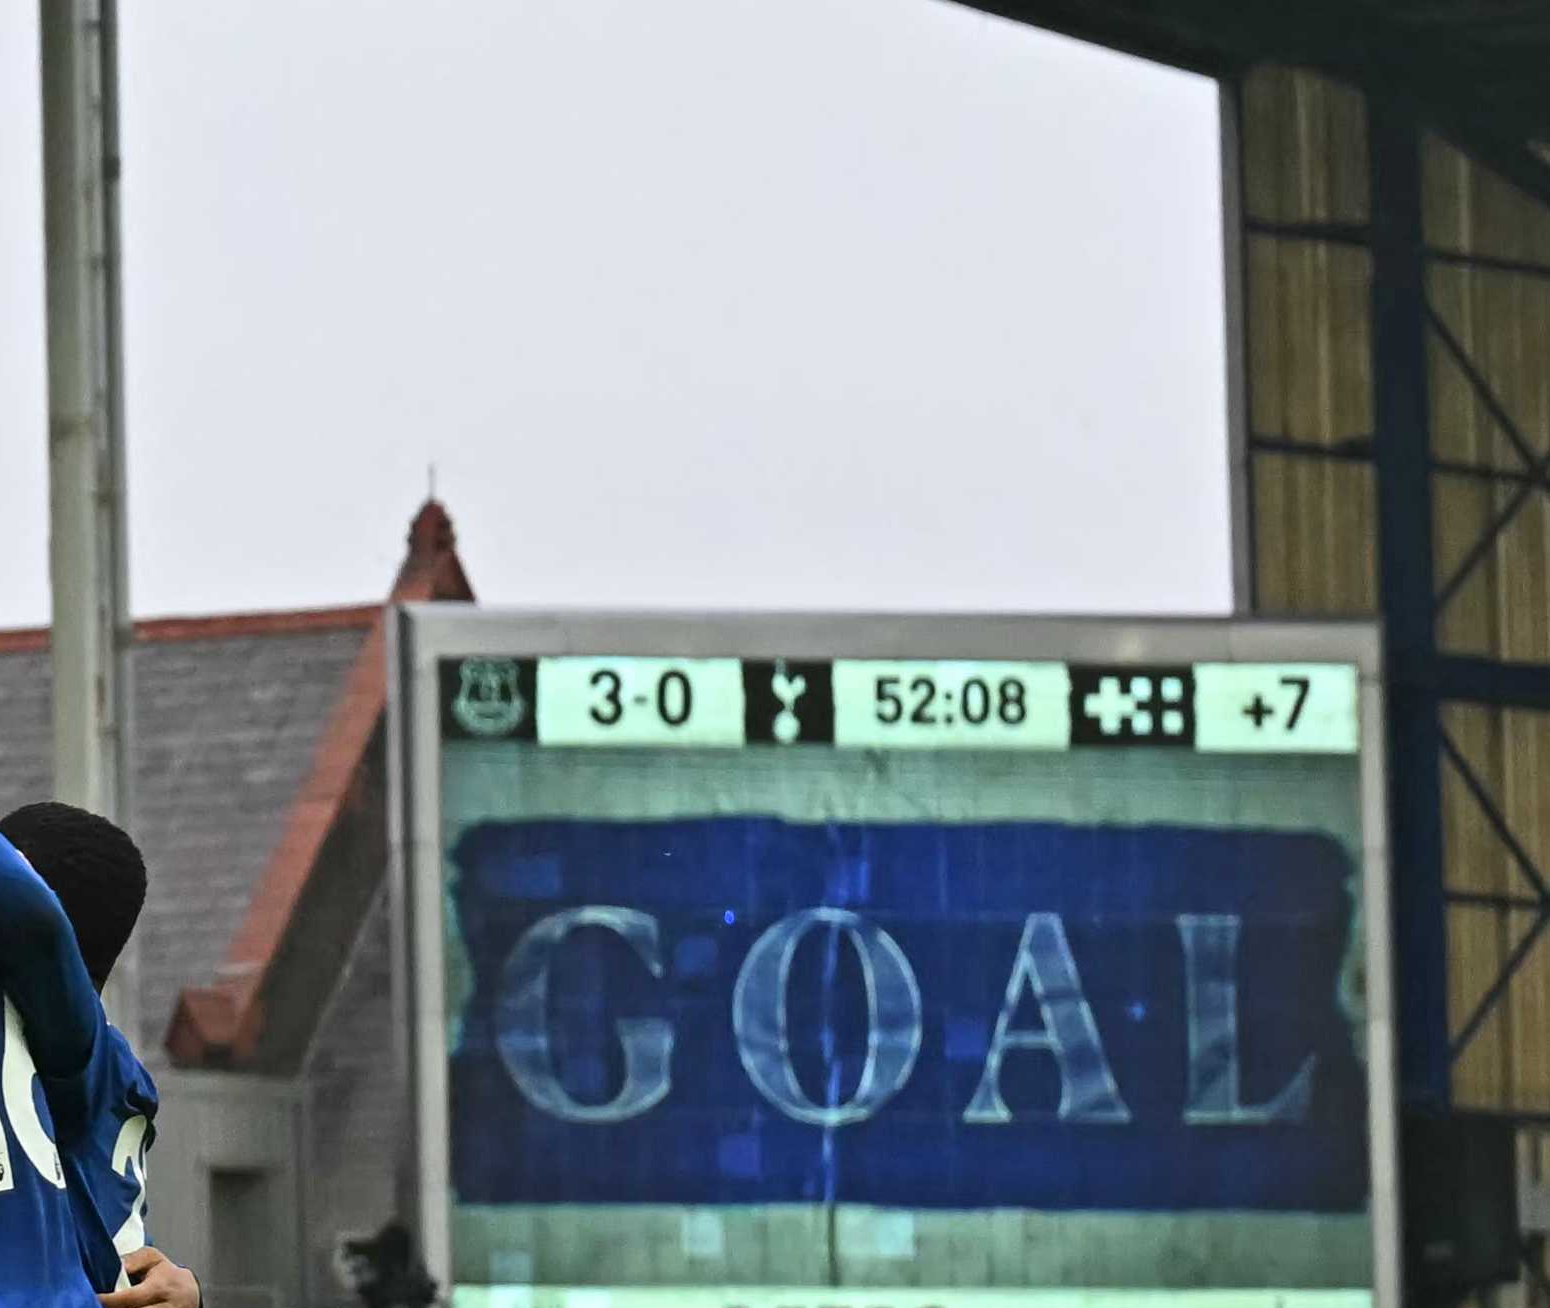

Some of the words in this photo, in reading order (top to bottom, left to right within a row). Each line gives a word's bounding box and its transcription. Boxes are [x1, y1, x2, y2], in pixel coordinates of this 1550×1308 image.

[589, 668, 695, 727] 3-0
[873, 676, 1030, 726] 52:08
[1240, 678, 1312, 731] +7
[498, 904, 1317, 1127] GOAL
